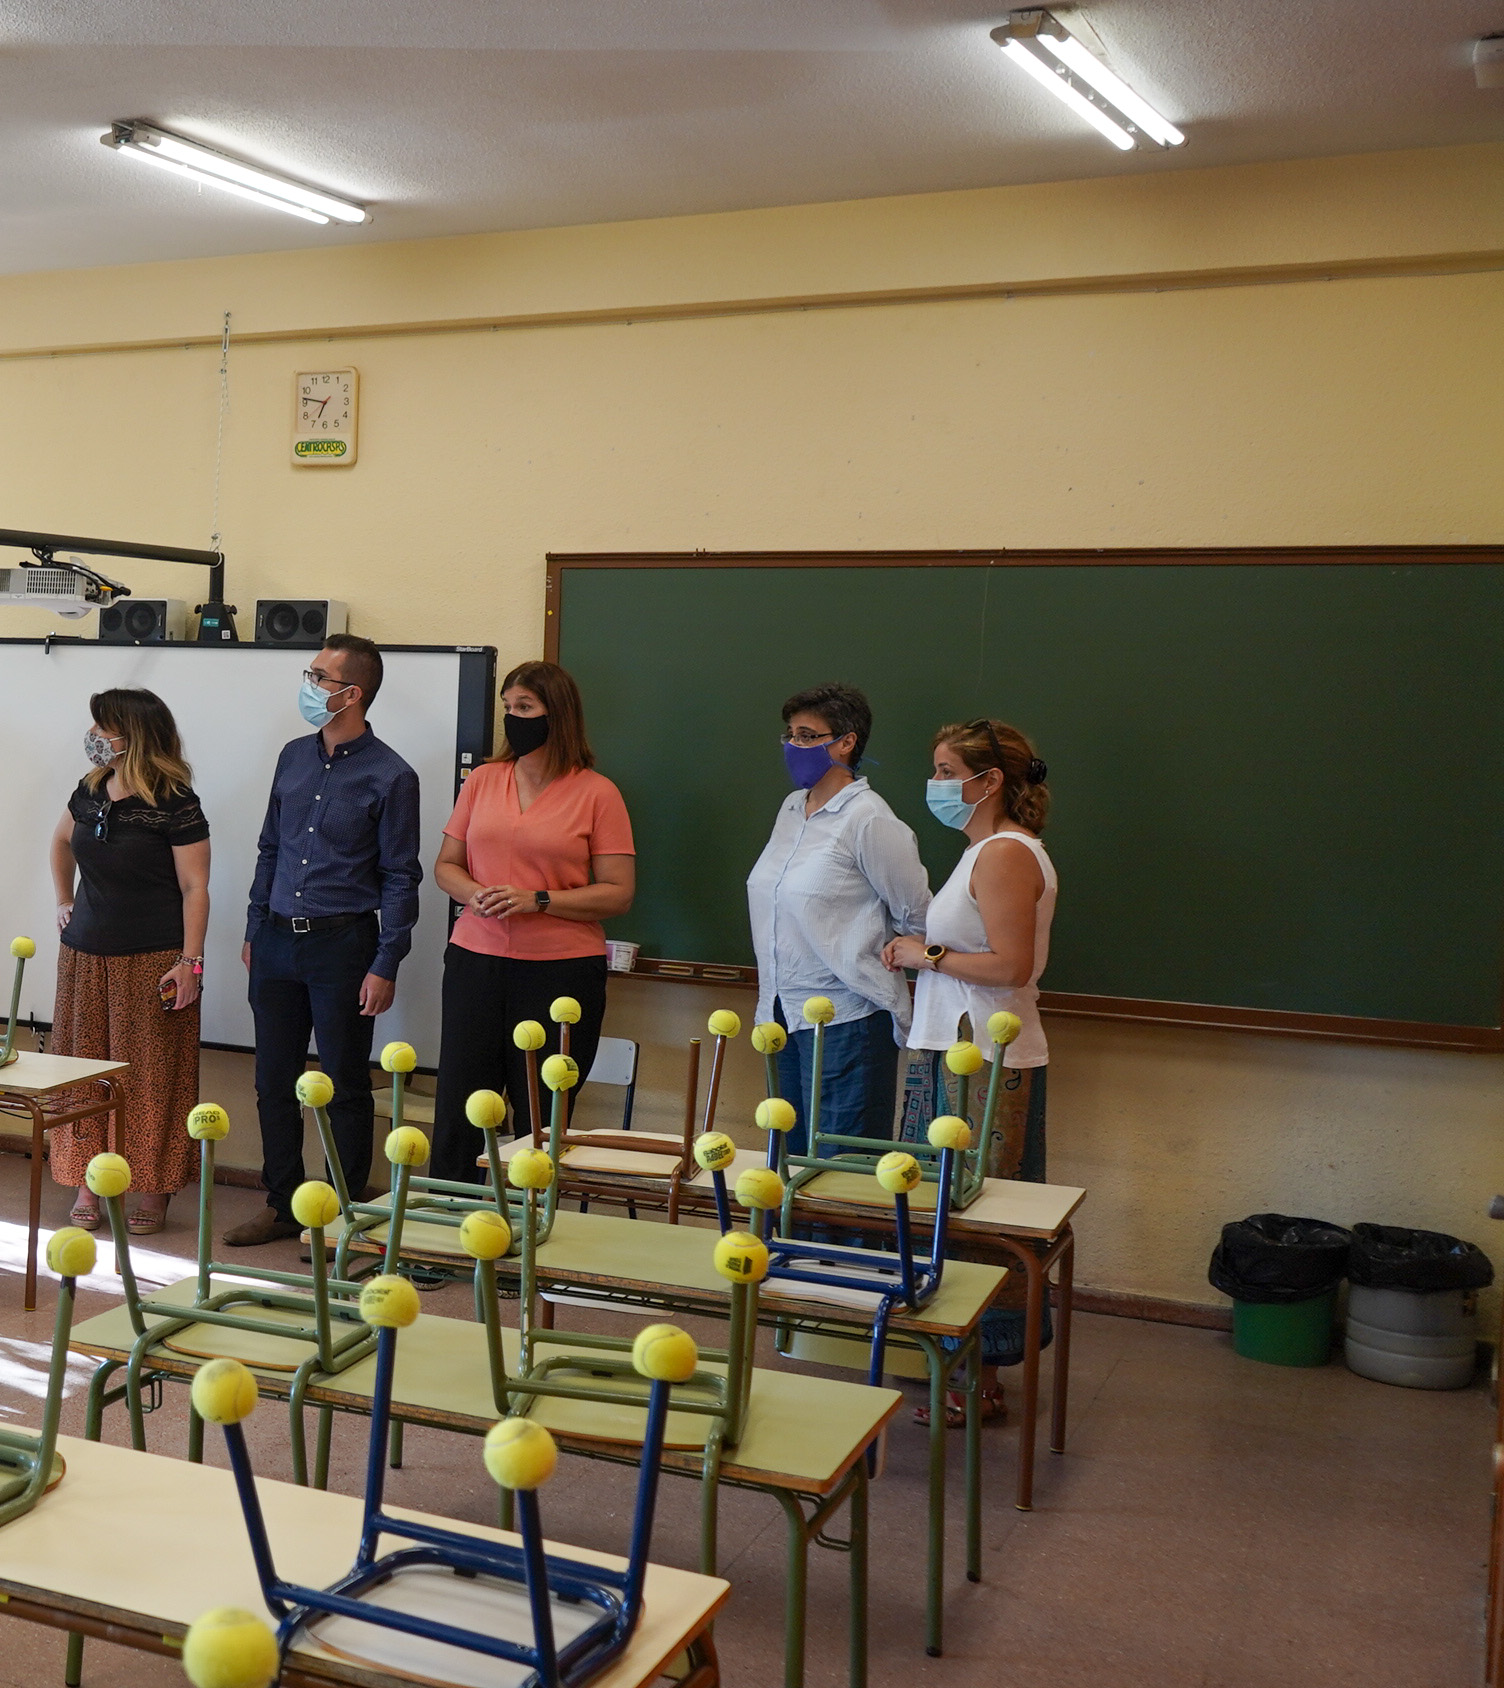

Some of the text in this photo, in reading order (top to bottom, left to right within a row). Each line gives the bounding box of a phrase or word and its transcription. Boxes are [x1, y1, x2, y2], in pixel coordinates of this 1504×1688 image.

[311, 377, 318, 385] 11
[322, 375, 331, 384] 12
[302, 386, 311, 394] 10
[343, 384, 349, 392] 2
[302, 398, 308, 407] 9
[344, 397, 350, 406] 3
[303, 411, 309, 420] 8
[342, 411, 348, 419] 4
[311, 420, 317, 428] 7
[322, 421, 328, 430] 6
[334, 420, 340, 428] 5
